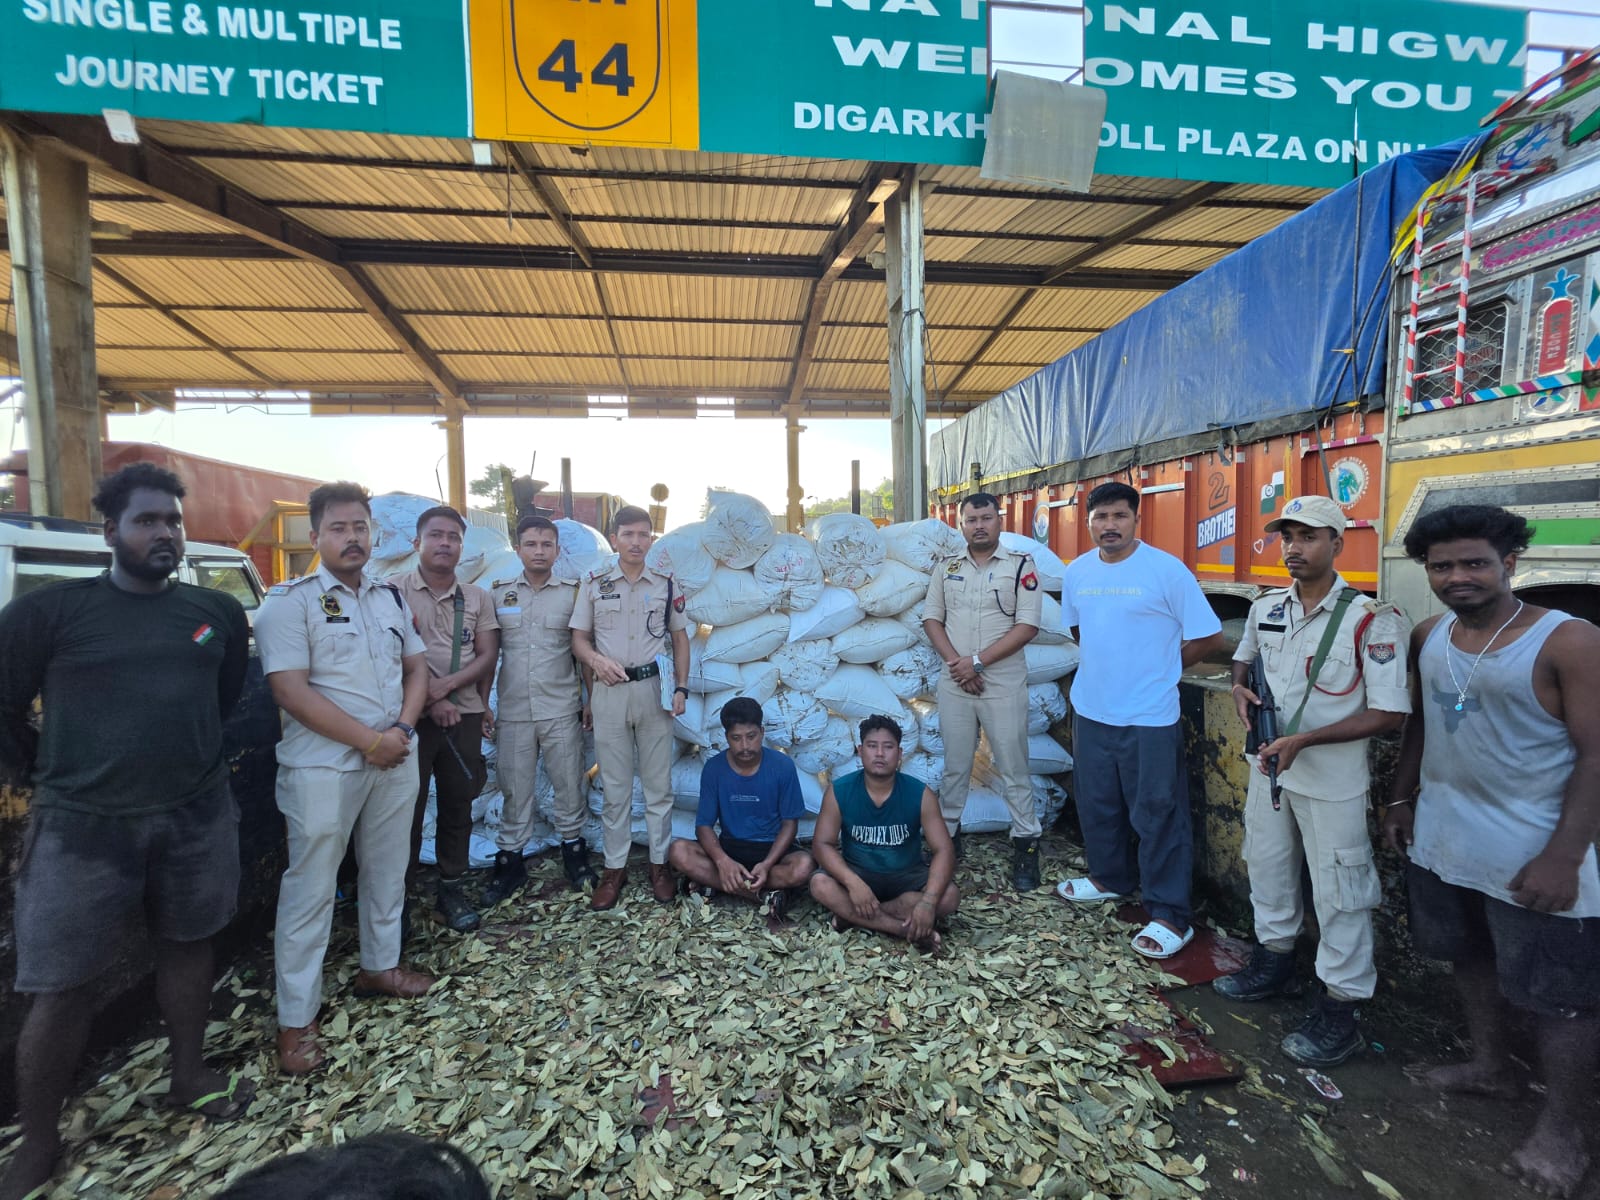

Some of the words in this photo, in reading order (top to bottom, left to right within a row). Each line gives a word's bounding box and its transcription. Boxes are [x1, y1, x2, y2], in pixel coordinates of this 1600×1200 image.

[22, 0, 173, 34] SINGLE
[182, 3, 208, 36] &
[217, 6, 402, 50] MULTIPLE
[815, 0, 1271, 46] ATNAL
[55, 54, 235, 97] JOURNEY
[248, 69, 384, 106] TICKET
[538, 39, 635, 97] 44
[832, 35, 1297, 99] WEOMES
[1321, 75, 1472, 112] YOU
[1098, 121, 1166, 152] OLL
[1177, 127, 1307, 162] PLAZA
[1314, 138, 1368, 163] ON
[1198, 506, 1236, 548] BROTHE
